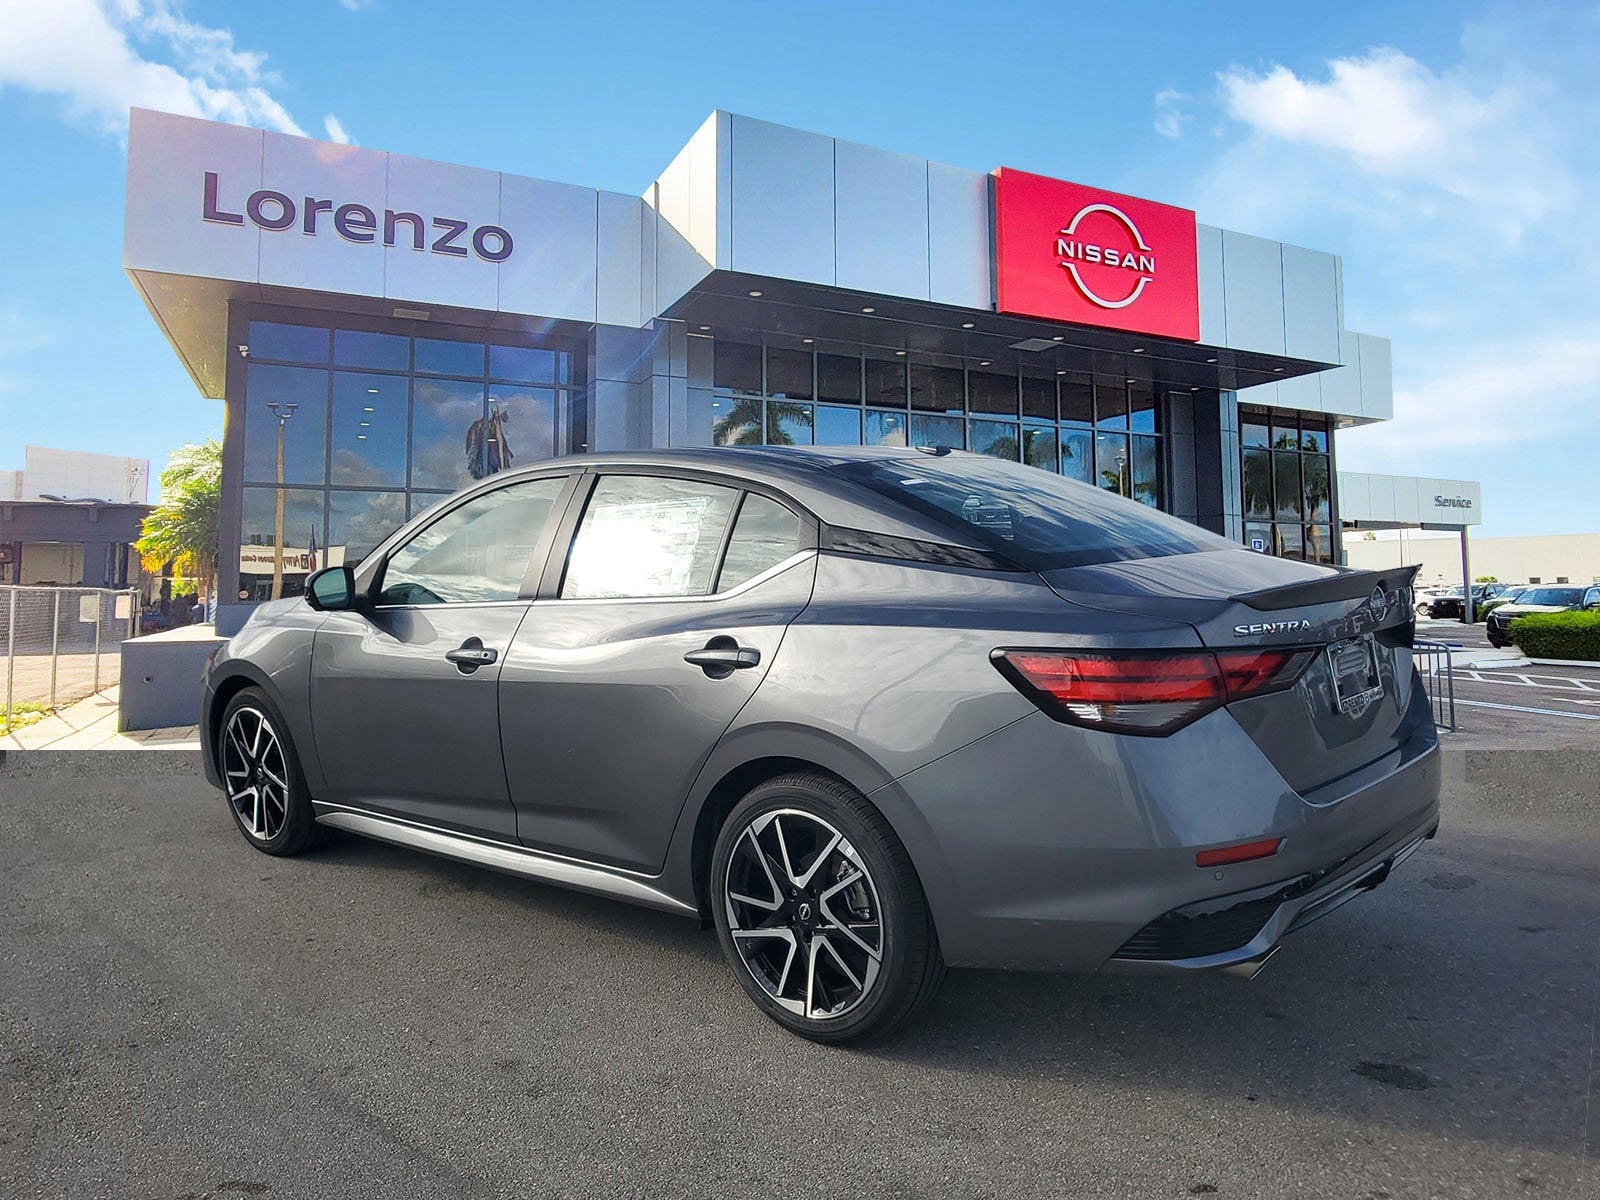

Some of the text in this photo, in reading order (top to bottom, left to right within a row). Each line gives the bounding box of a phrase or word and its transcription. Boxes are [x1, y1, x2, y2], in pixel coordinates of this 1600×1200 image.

[202, 170, 514, 263] Lorenzo
[1057, 238, 1155, 273] NISSAN
[1434, 495, 1472, 509] Service
[1232, 619, 1312, 638] SENTRA
